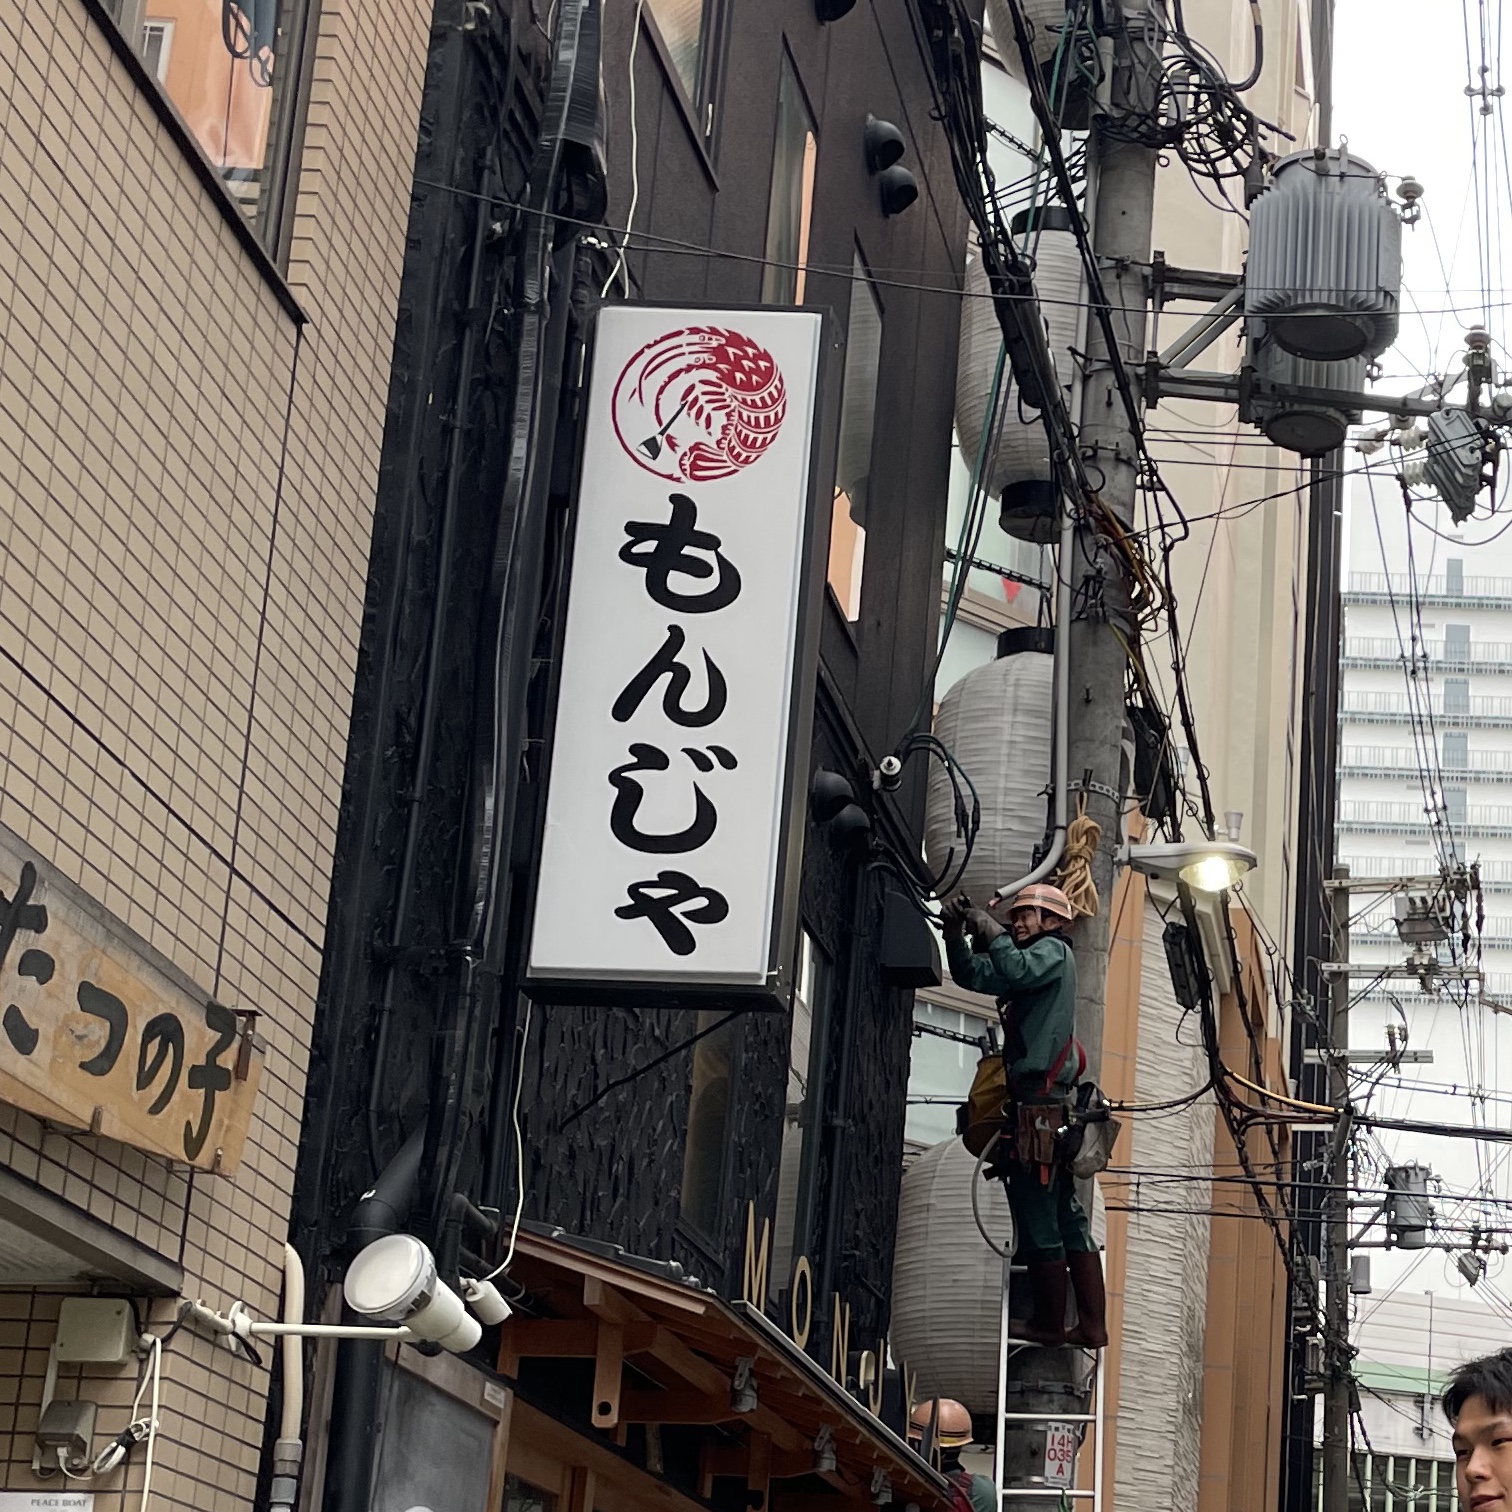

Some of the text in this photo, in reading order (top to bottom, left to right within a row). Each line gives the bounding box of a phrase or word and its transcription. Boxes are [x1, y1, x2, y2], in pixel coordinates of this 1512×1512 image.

[1056, 1463, 1065, 1476] A
[31, 1498, 87, 1507] PEACE BOAT
